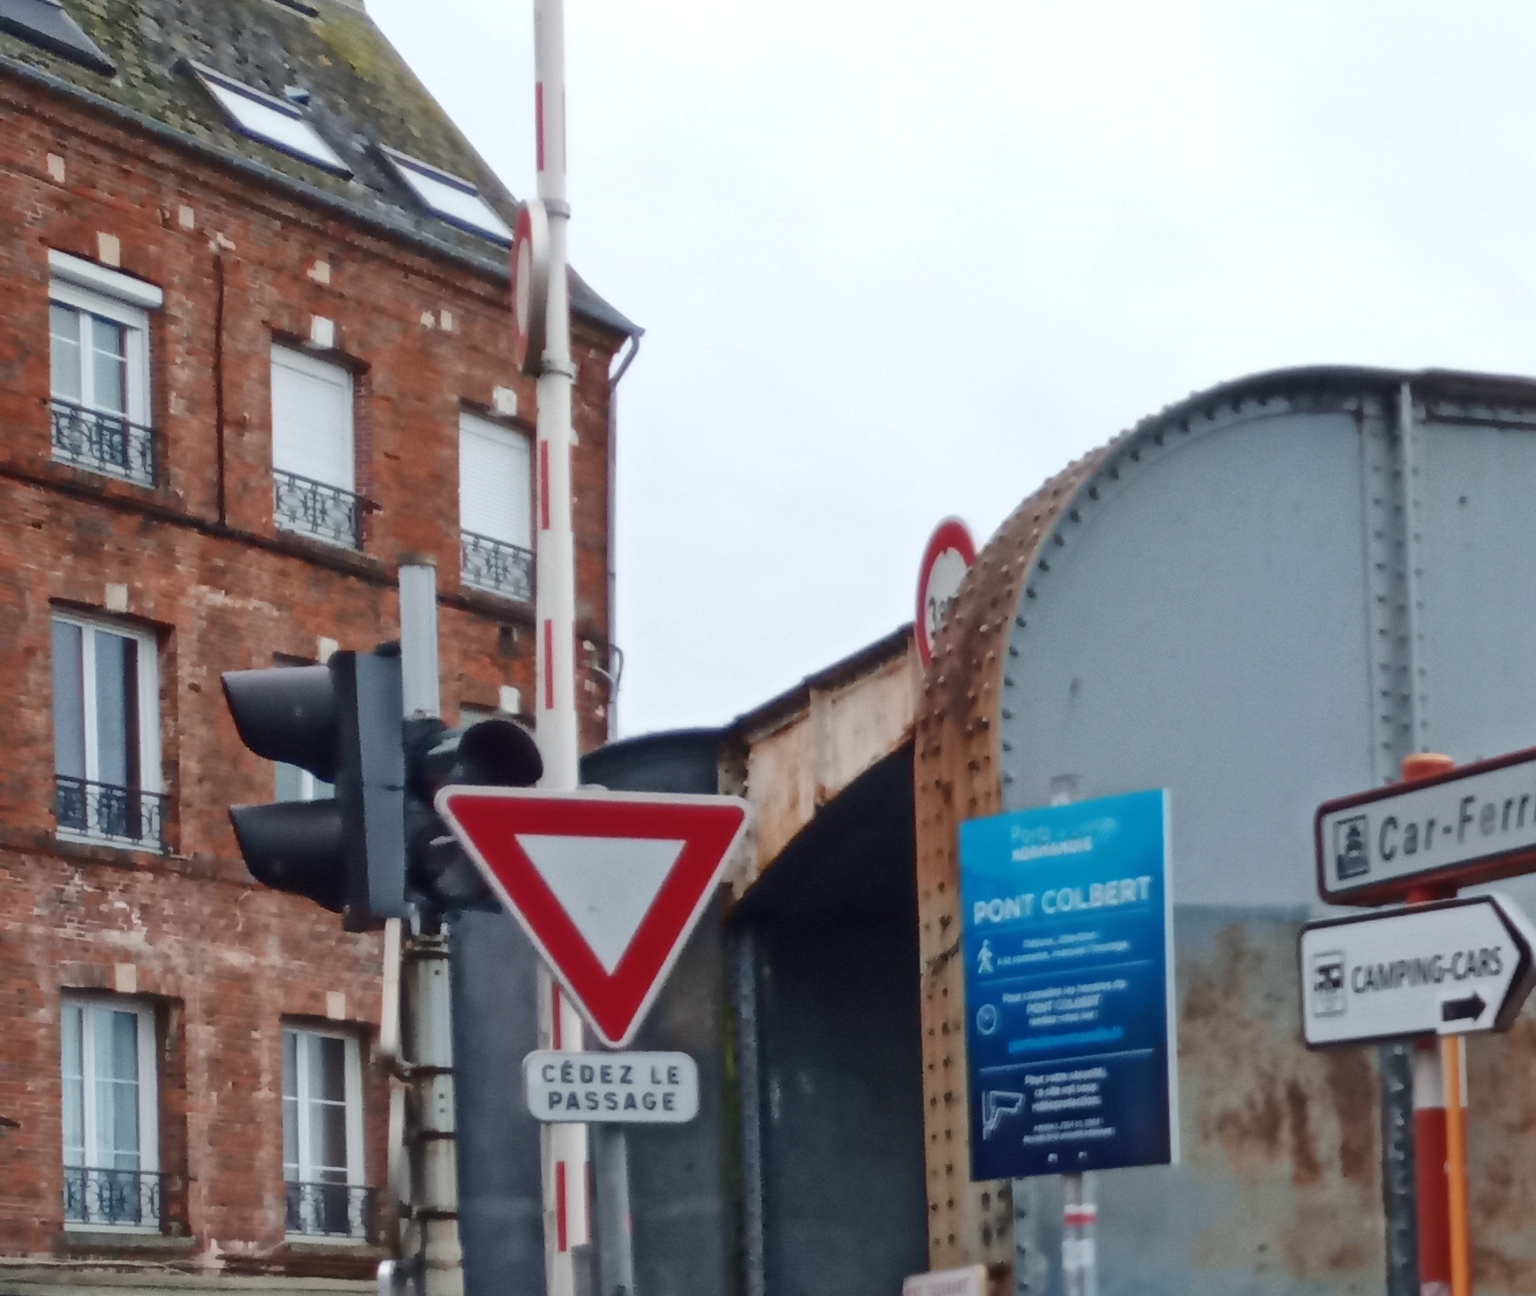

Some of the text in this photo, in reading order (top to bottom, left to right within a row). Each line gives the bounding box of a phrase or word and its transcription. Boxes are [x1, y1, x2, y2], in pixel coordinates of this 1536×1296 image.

[973, 875, 1154, 925] PONT COLBERT
[1350, 945, 1505, 994] CAMPING-CARS
[541, 1060, 679, 1085] CÉDEZ LE
[548, 1091, 676, 1112] PASSAGE
